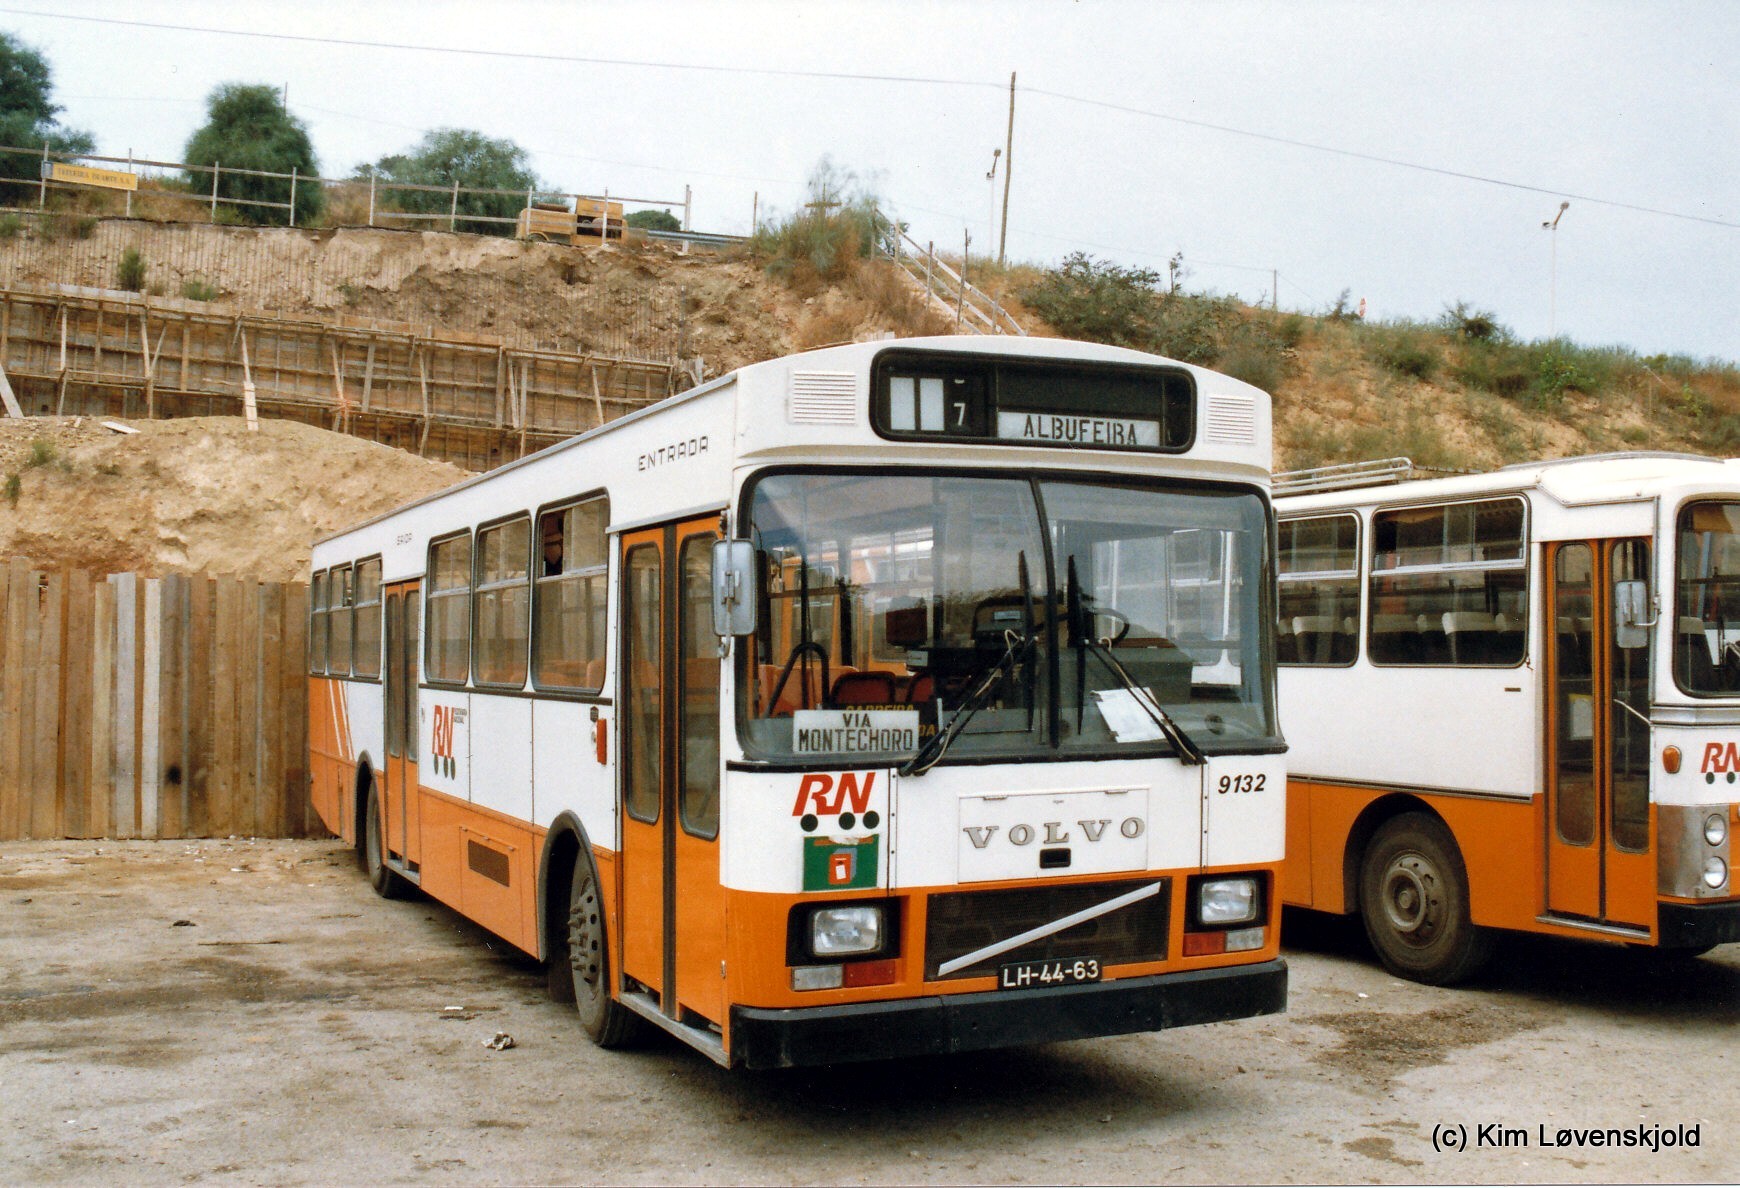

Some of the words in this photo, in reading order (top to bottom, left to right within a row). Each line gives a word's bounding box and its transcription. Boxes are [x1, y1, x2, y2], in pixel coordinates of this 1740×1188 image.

[953, 403, 966, 426] 7
[1023, 414, 1138, 446] ALBUFEIRA
[638, 434, 710, 471] ENTRADA
[432, 704, 455, 759] RN
[842, 713, 872, 728] VIA
[799, 729, 914, 752] MONTECHORO
[791, 771, 876, 817] RN
[1217, 773, 1267, 794] 9132
[963, 816, 1145, 849] VOLVO
[1003, 959, 1100, 988] LH-44-63
